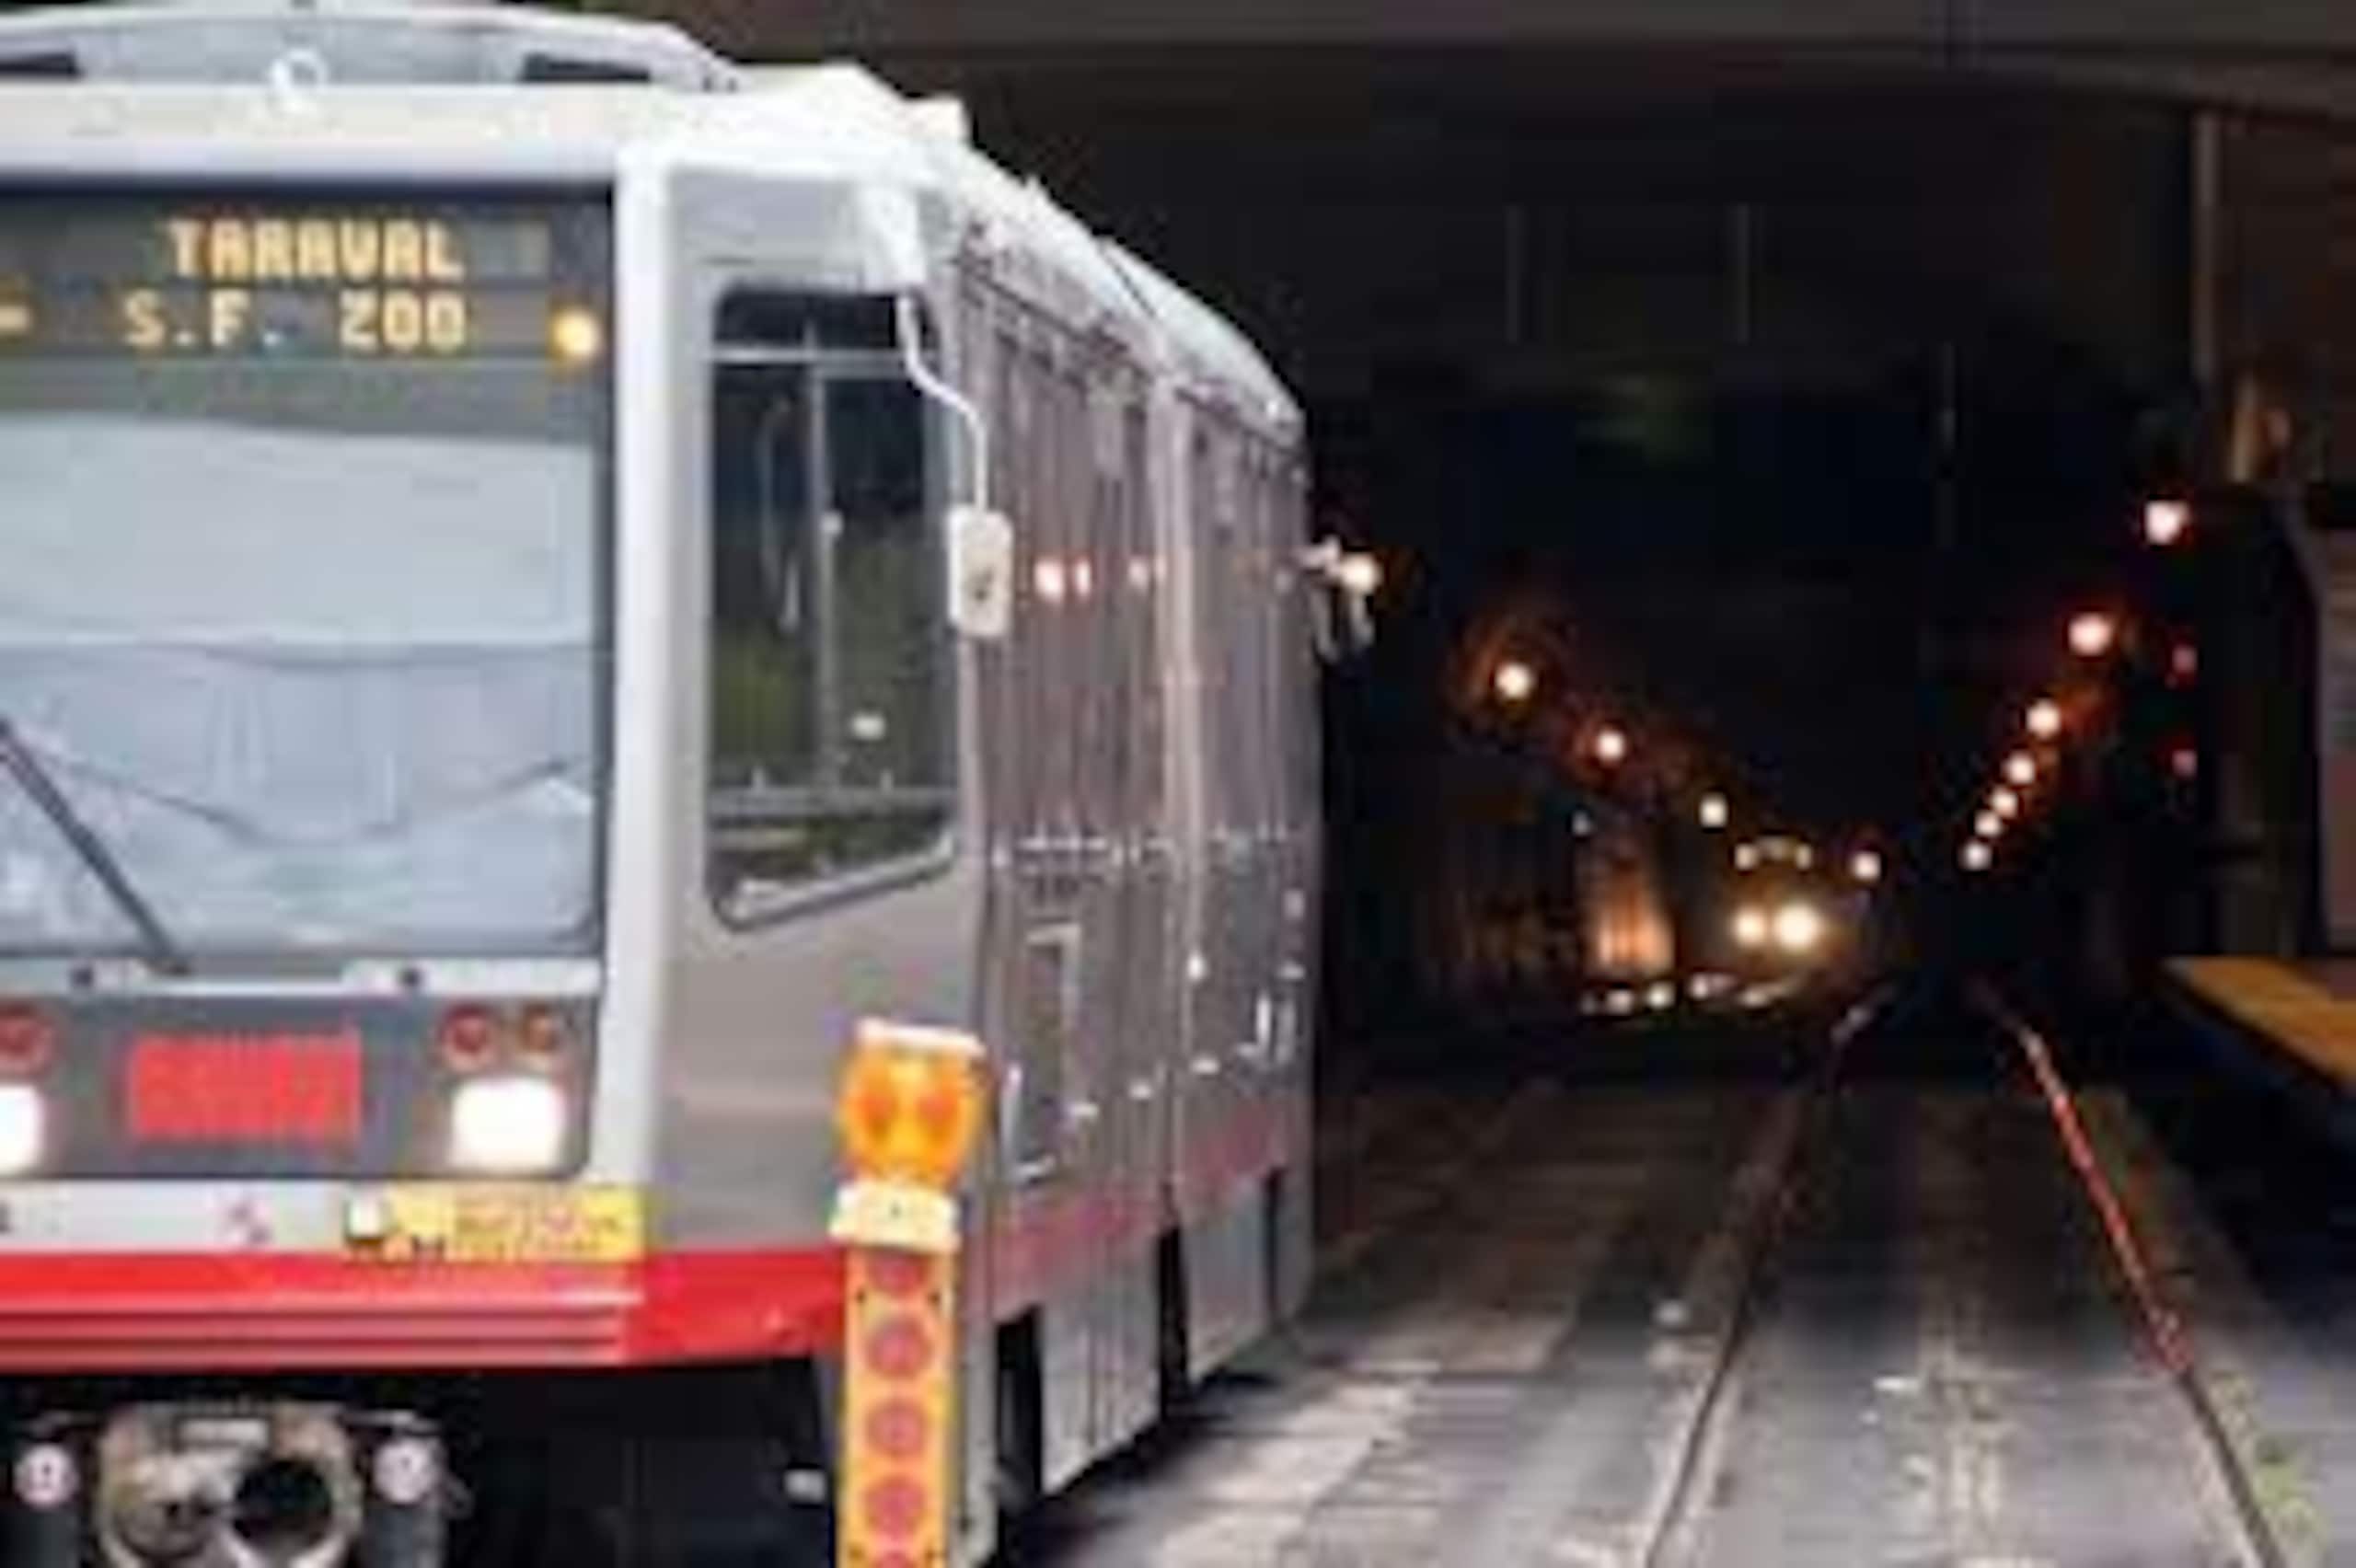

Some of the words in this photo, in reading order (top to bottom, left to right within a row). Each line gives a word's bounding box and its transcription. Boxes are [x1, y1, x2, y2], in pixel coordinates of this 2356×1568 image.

[167, 218, 465, 278] TARAVAL
[123, 291, 283, 348] S.F.
[339, 291, 466, 348] ZOO
